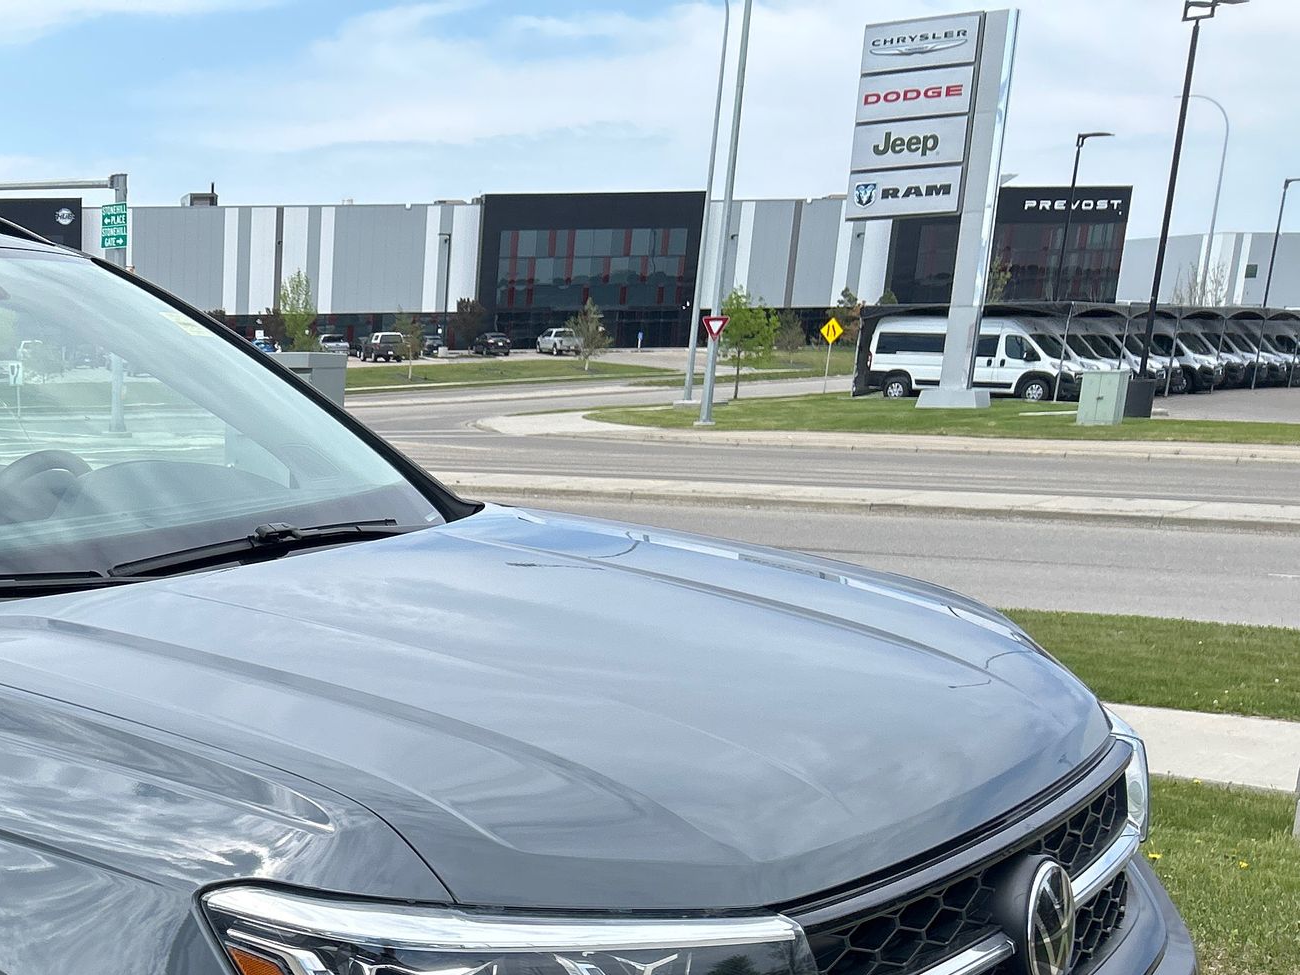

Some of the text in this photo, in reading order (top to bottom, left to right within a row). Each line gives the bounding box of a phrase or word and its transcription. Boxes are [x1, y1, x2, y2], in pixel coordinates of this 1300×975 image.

[871, 29, 968, 47] CHRYSLER
[863, 84, 964, 106] DODGE
[872, 131, 939, 157] Jeep
[880, 183, 952, 199] RAM
[102, 205, 126, 215] STONEHILL
[1024, 199, 1122, 210] PREVOST
[110, 215, 126, 225] PLACE
[102, 226, 126, 236] STONEHILL
[104, 237, 117, 247] GATE
